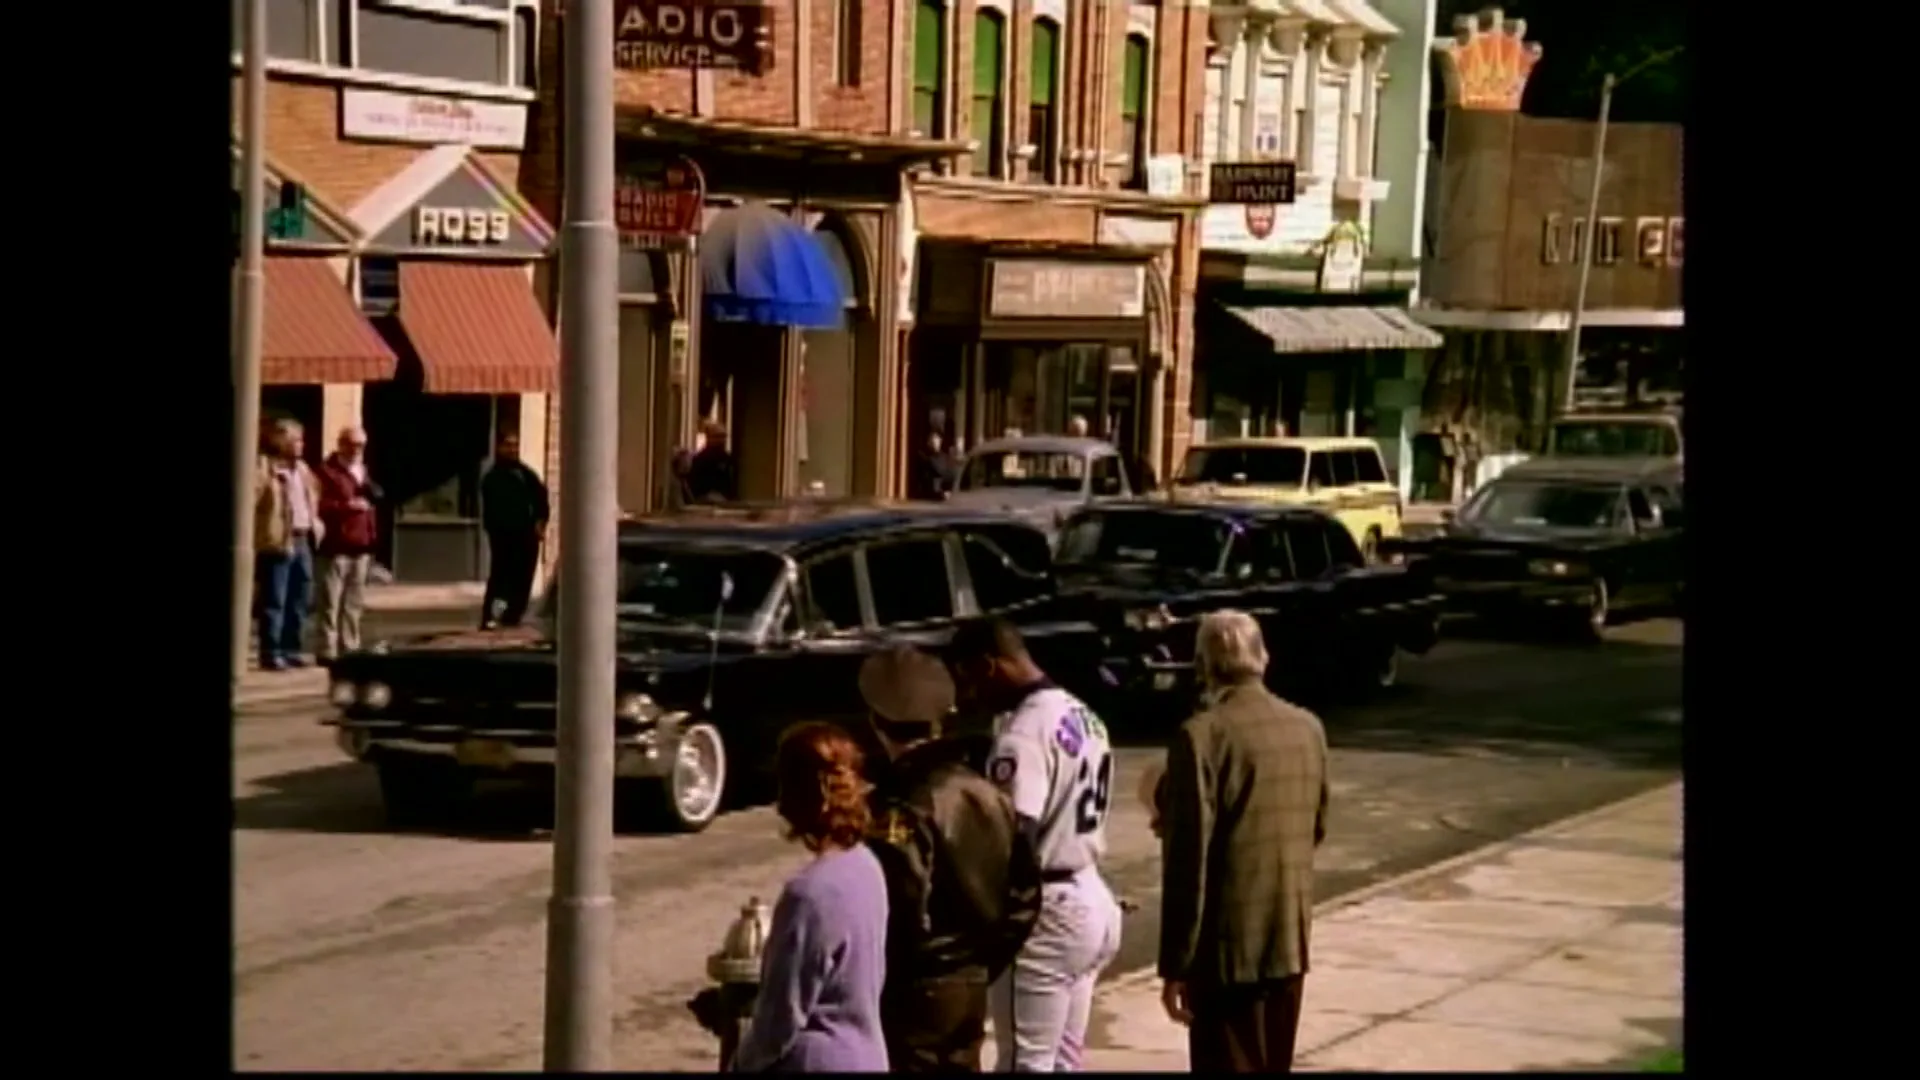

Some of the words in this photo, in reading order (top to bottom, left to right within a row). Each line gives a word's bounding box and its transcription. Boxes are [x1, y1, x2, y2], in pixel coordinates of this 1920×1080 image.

[618, 4, 744, 46] ADIO
[1235, 183, 1290, 201] PAINT
[420, 207, 510, 241] ROSS
[1075, 753, 1111, 834] 24
